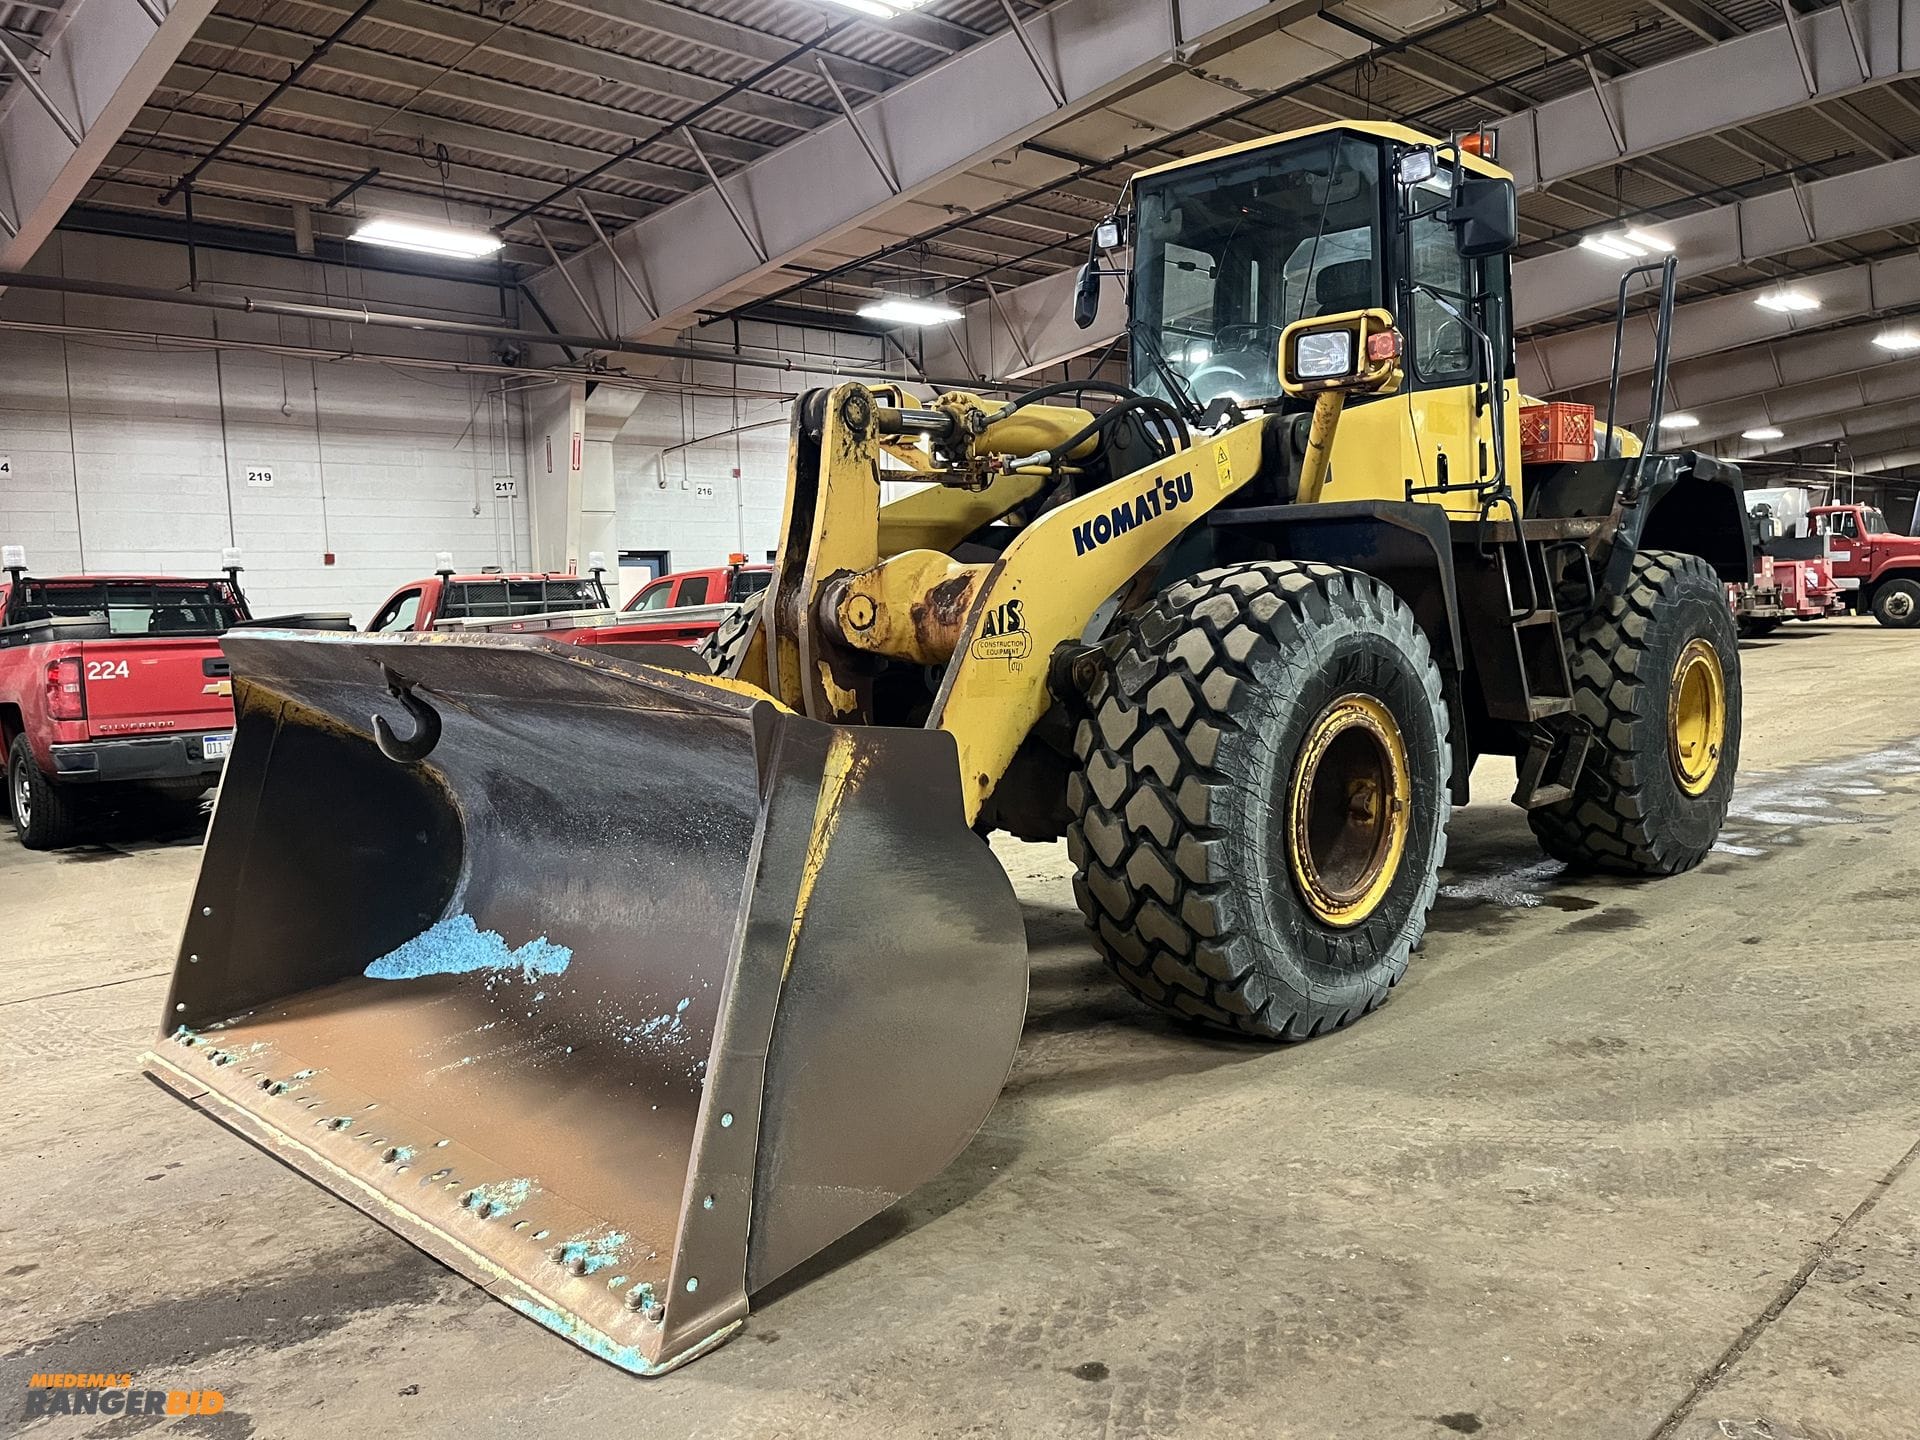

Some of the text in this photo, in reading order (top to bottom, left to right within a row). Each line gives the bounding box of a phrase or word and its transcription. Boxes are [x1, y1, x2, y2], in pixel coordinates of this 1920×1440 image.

[248, 472, 272, 481] 219
[495, 482, 514, 491] 217
[697, 487, 713, 496] 216
[1072, 471, 1194, 557] KOMATSU
[980, 598, 1026, 639] AIS
[980, 640, 1024, 648] CONSTRUCTION
[986, 648, 1019, 656] EQUIPMENT
[87, 660, 130, 680] 224
[99, 720, 176, 732] SILVERADO
